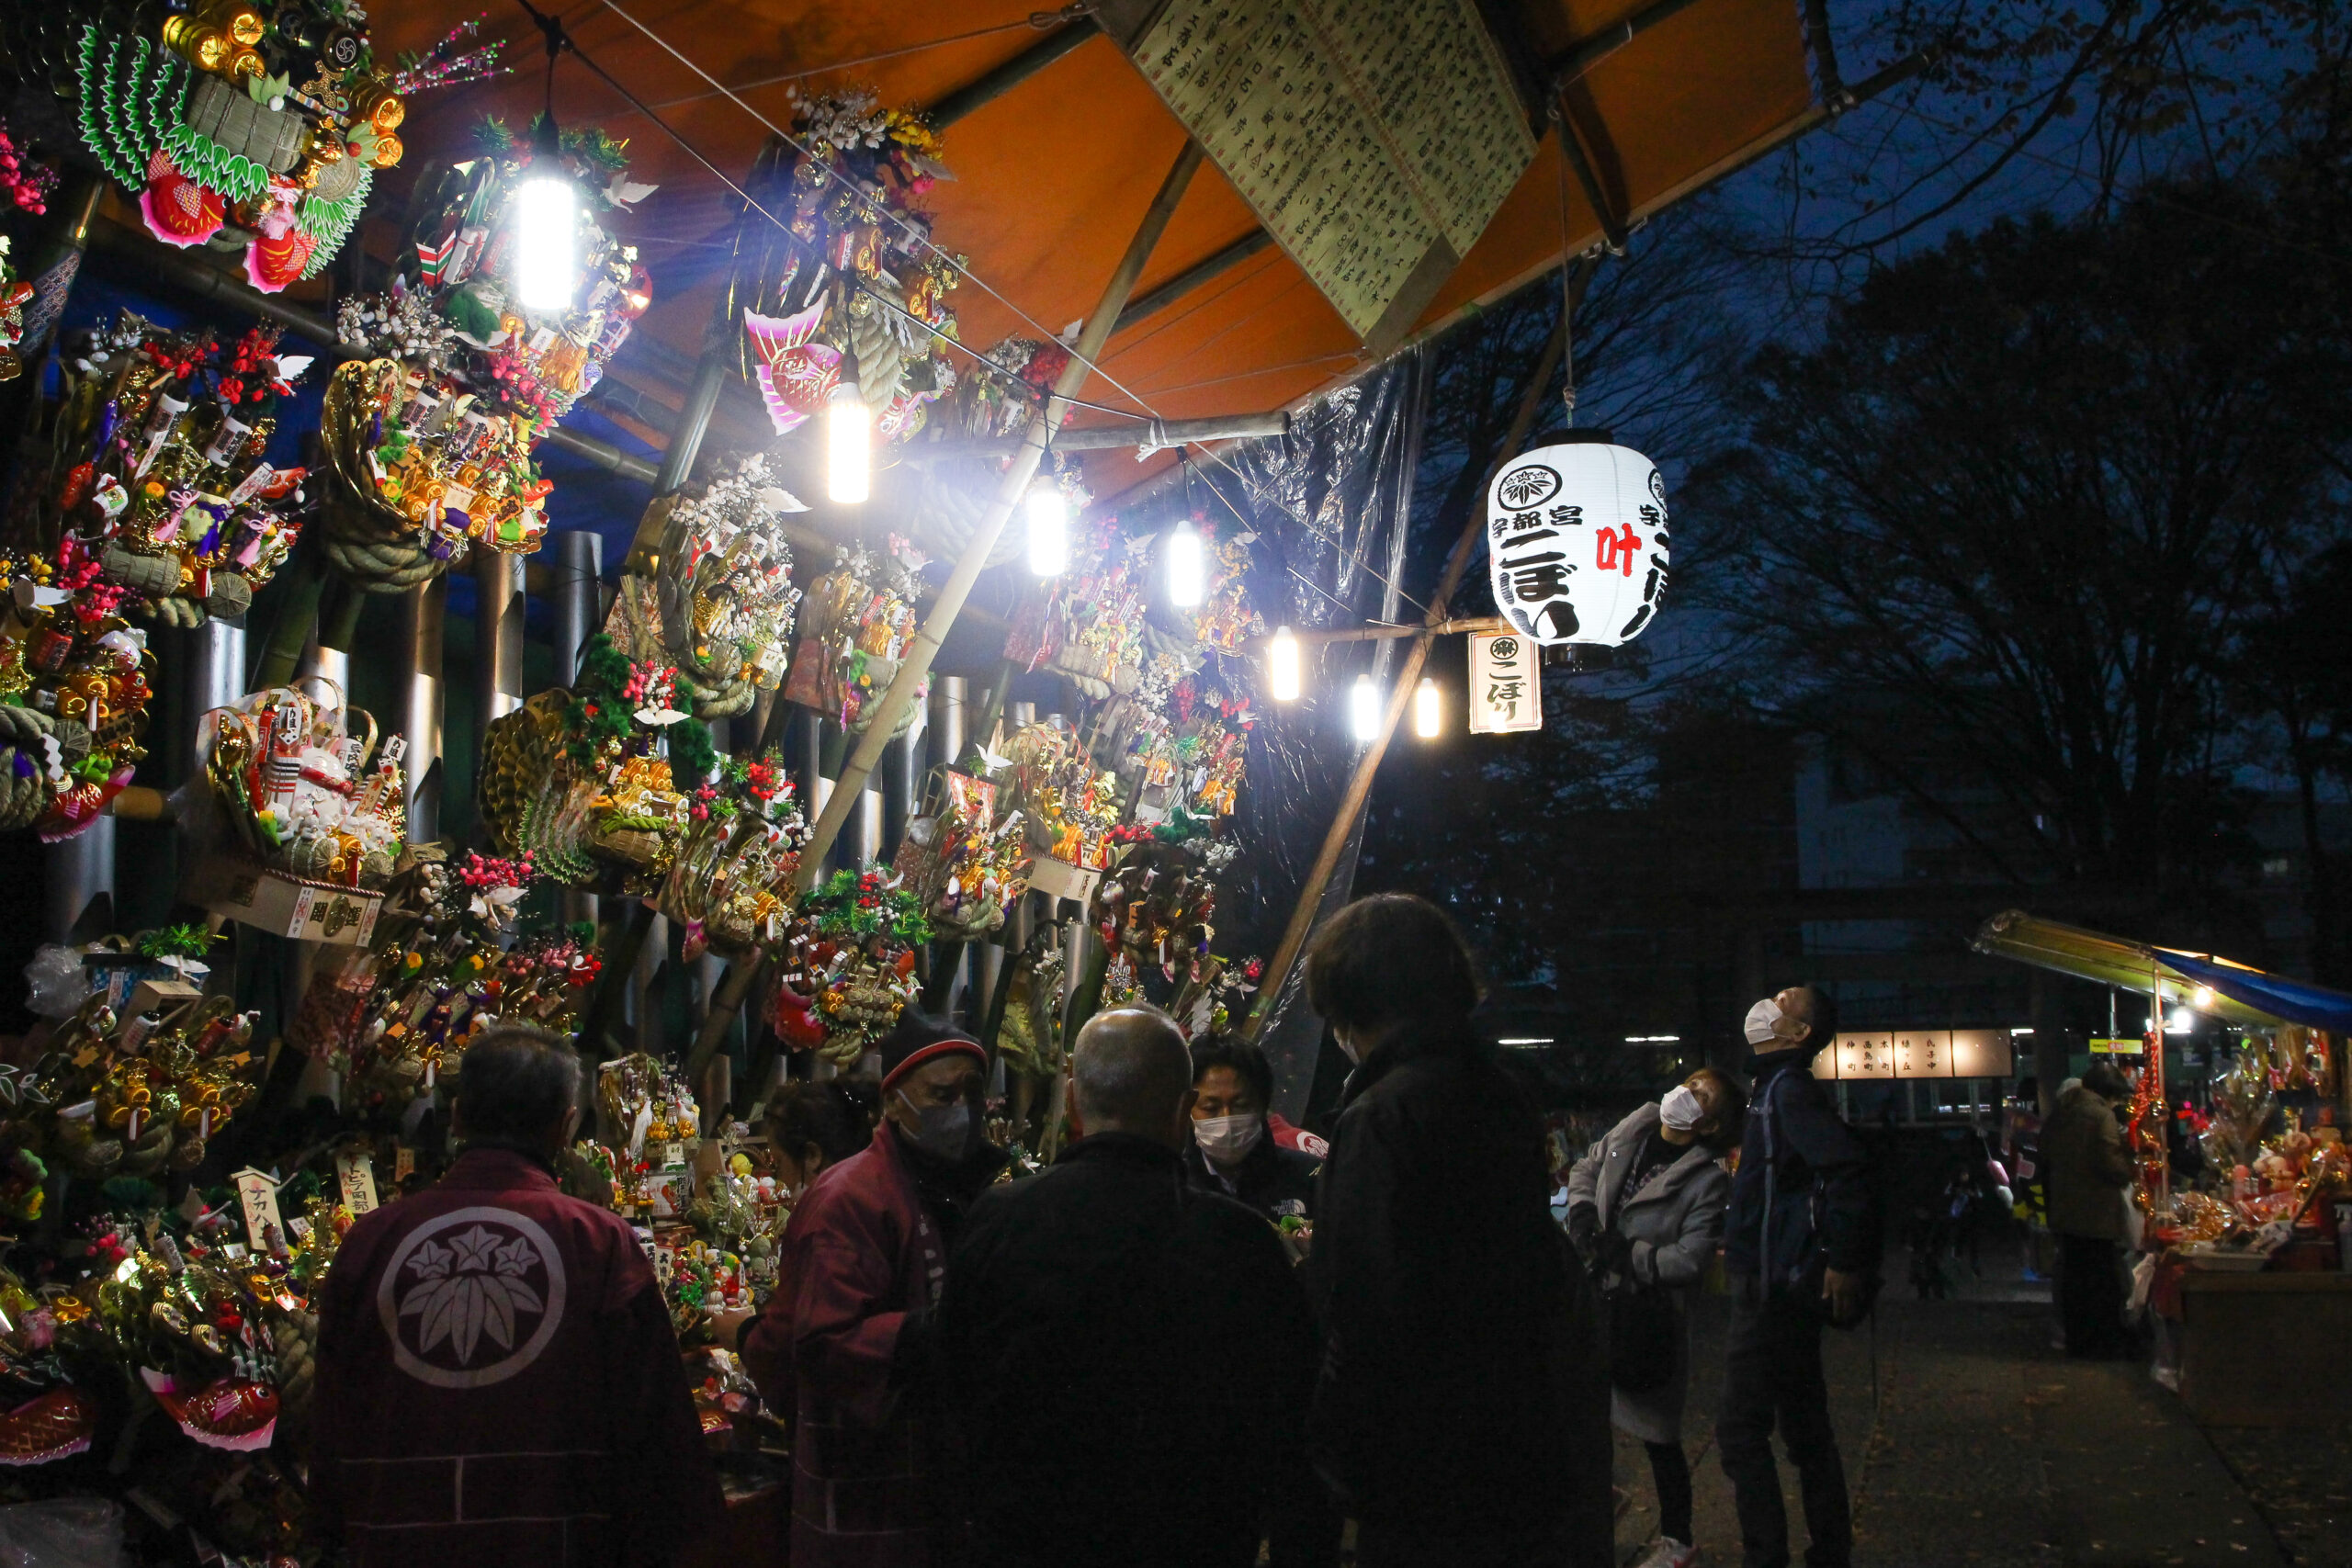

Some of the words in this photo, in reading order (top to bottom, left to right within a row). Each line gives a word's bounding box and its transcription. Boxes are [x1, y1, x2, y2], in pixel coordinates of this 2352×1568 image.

[1492, 505, 1583, 539] 宇都宮
[1596, 523, 1642, 578] 叶
[1487, 660, 1527, 722] こぼり
[1927, 1039, 1936, 1070] 氏子中
